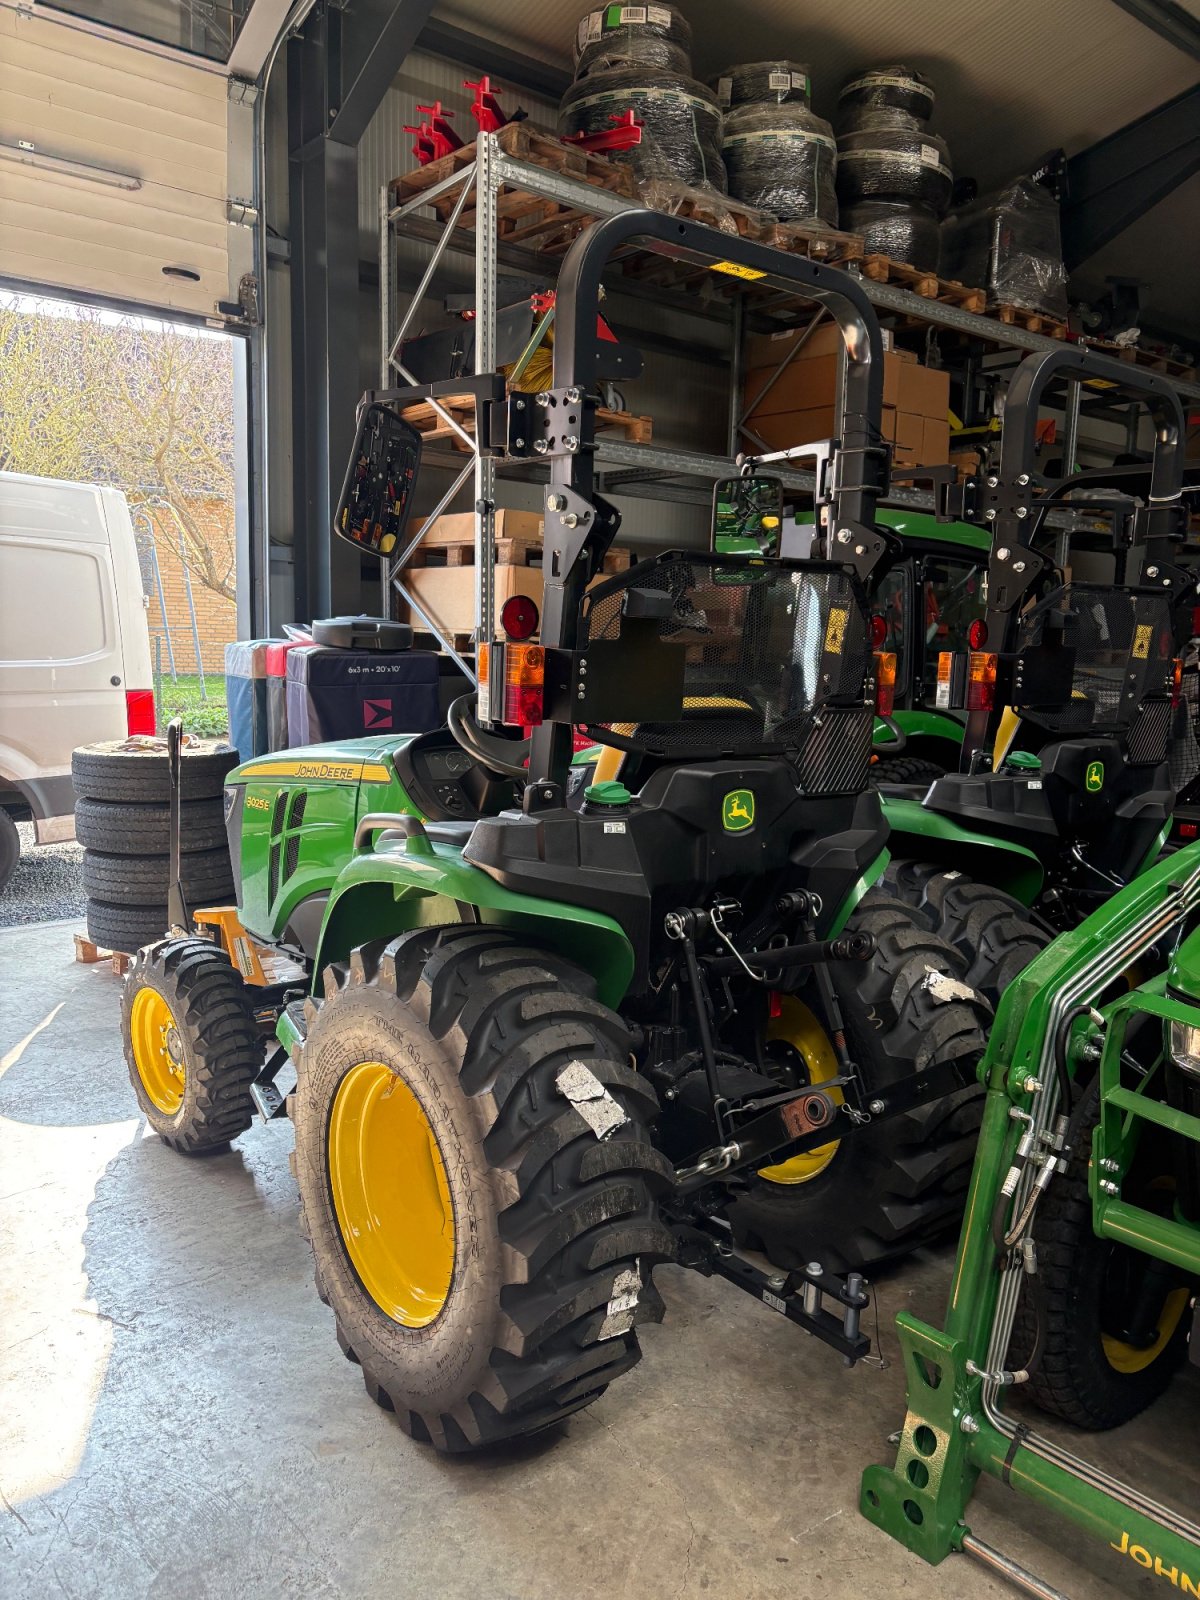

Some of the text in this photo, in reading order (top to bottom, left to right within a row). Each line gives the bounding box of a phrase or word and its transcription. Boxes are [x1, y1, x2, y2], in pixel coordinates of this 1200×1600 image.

[348, 666, 361, 674] 6x3
[294, 764, 354, 779] JOHN DEERE
[1110, 1531, 1200, 1600] JOHN
